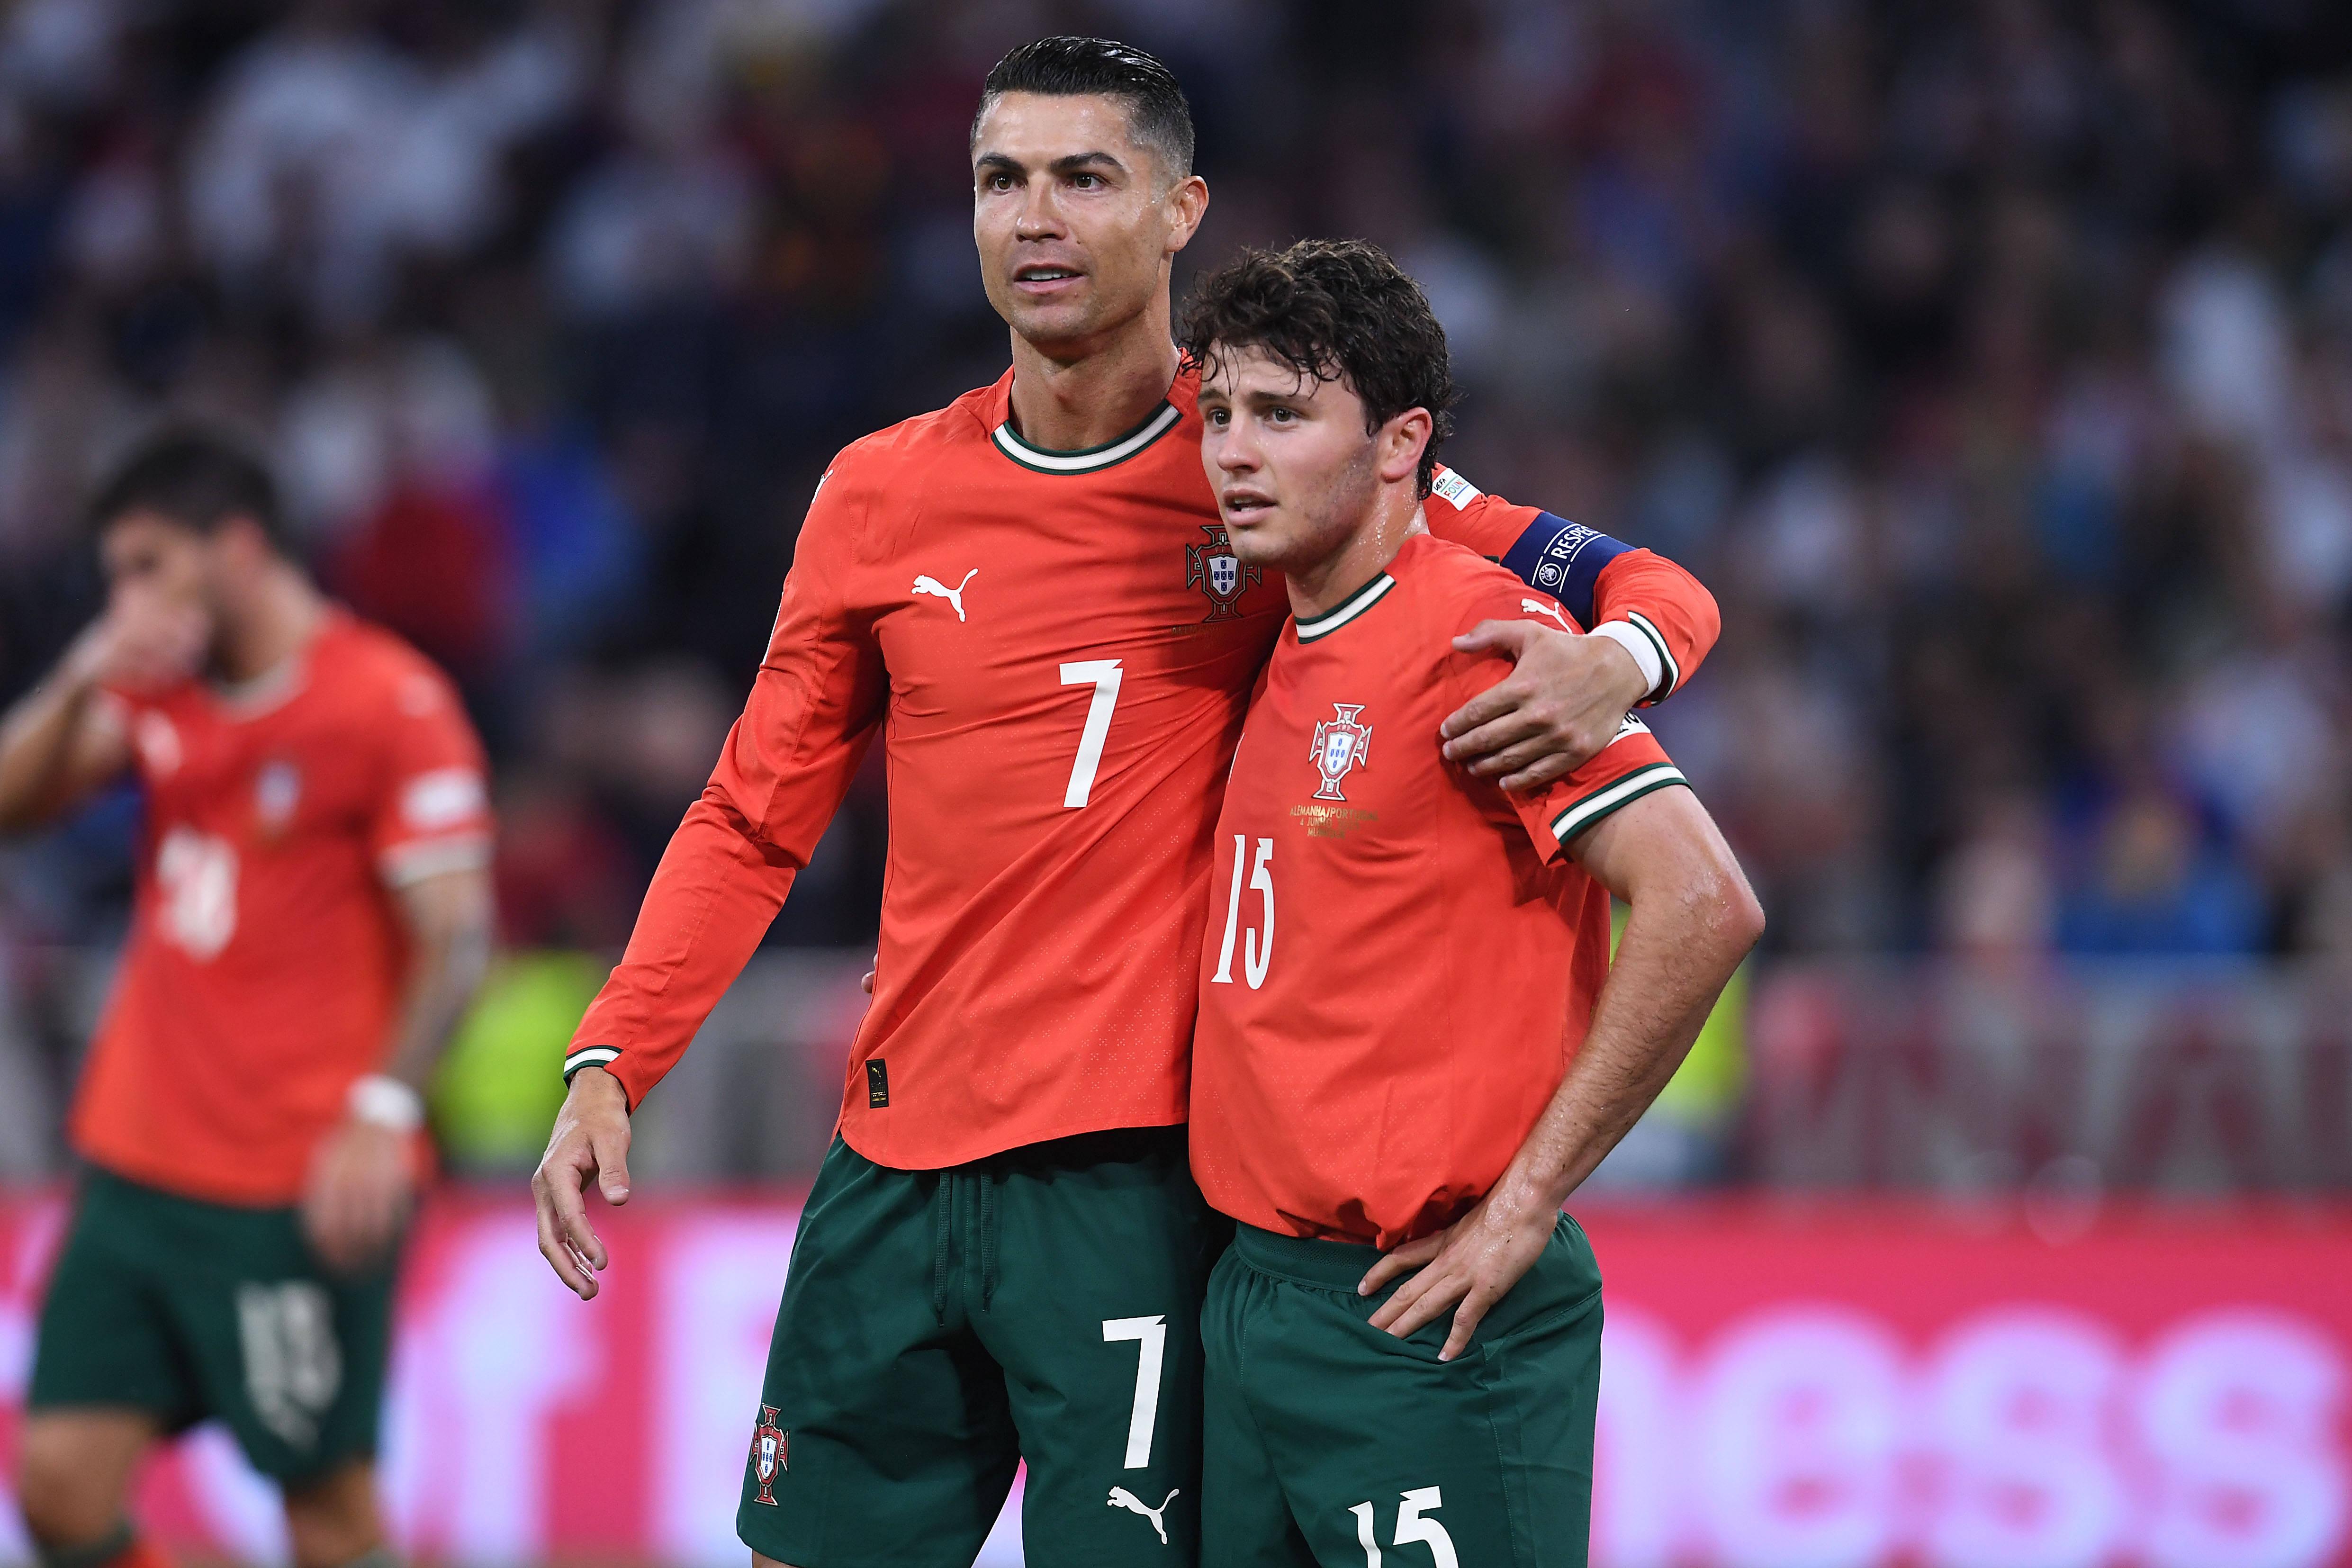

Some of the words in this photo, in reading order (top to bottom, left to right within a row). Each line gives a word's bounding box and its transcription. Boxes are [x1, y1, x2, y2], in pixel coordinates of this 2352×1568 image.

[1433, 478, 1447, 491] UEFA
[1550, 525, 1601, 559] RESPEC
[1059, 659, 1123, 807] 7
[1210, 834, 1275, 990] 15
[1102, 1315, 1166, 1469] 7
